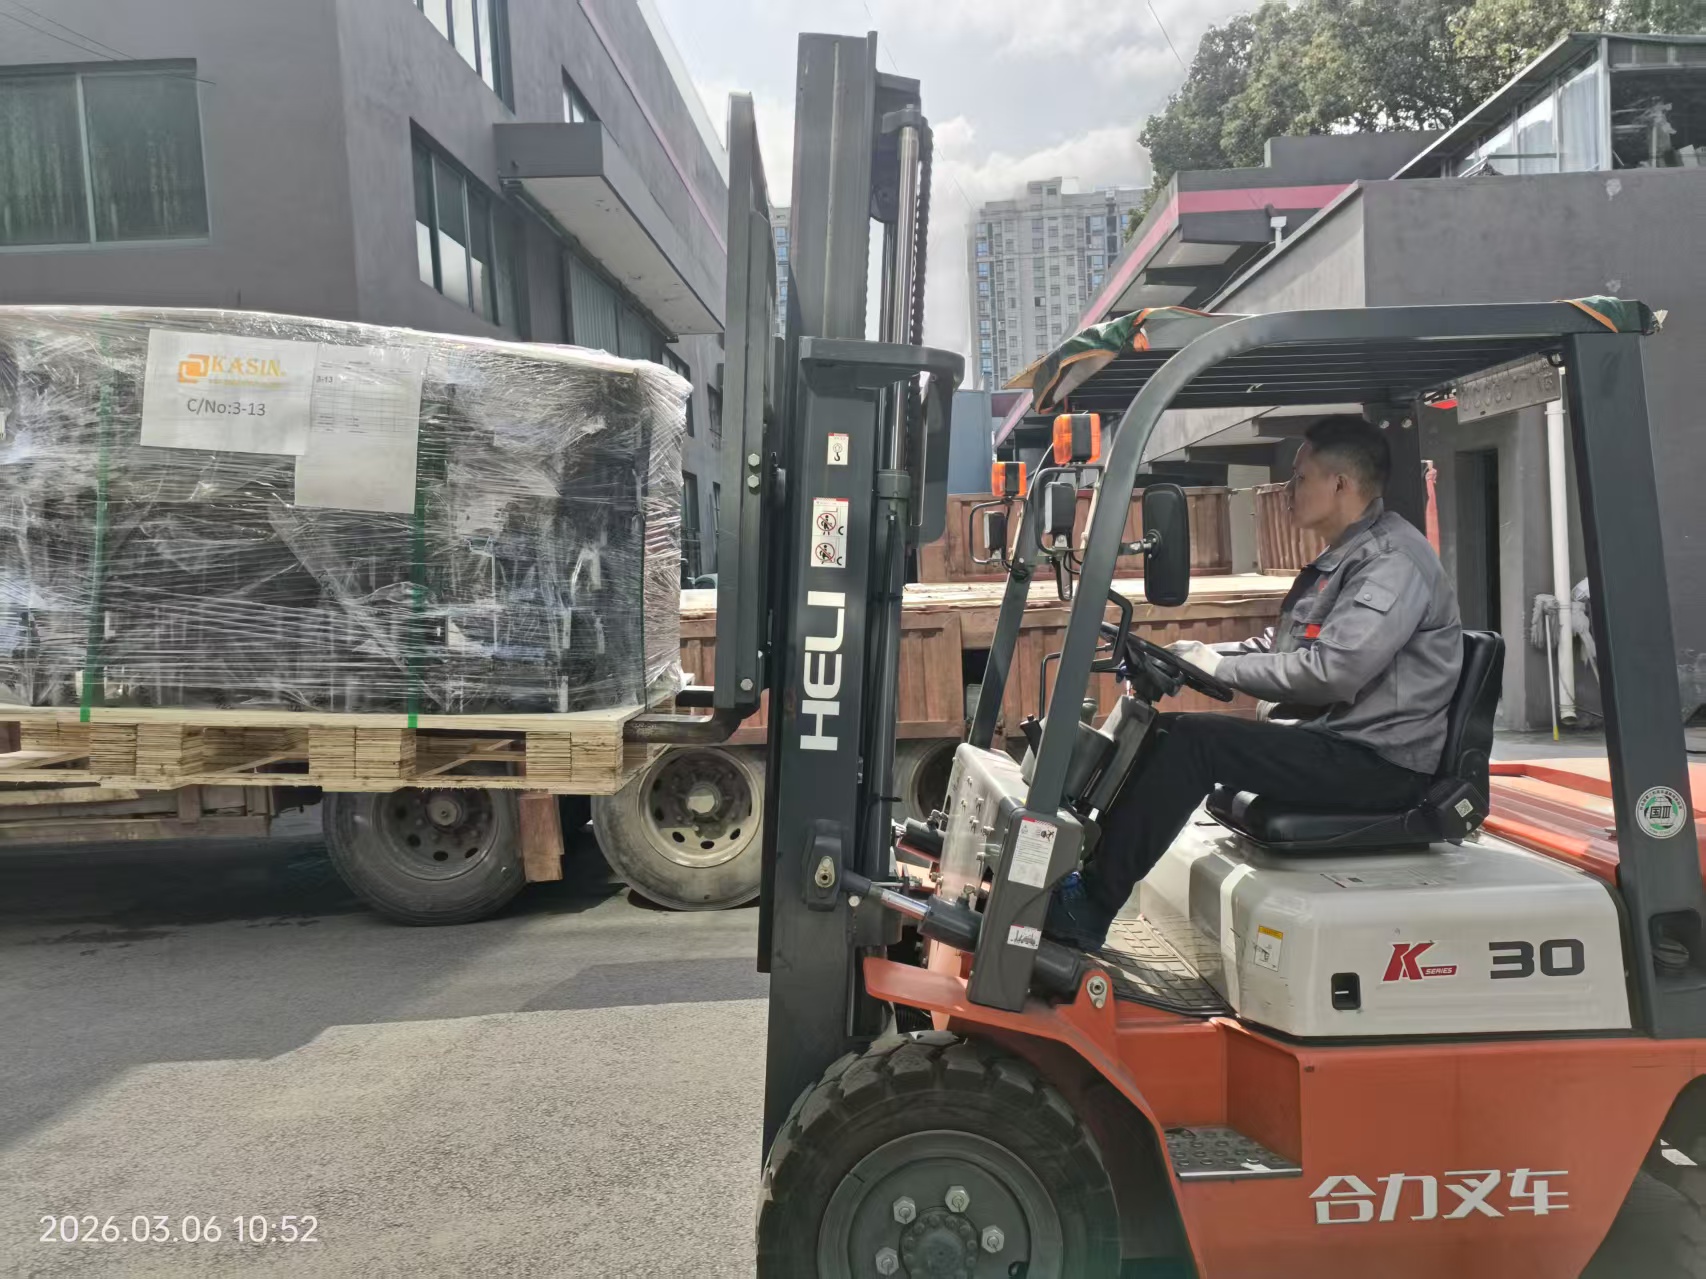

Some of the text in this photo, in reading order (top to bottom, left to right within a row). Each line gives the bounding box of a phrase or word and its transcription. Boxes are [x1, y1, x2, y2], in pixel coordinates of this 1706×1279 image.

[187, 398, 266, 416] C/No:3-13
[800, 591, 846, 751] HELI
[1382, 943, 1453, 982] K SERIES
[1489, 938, 1585, 979] 30
[1308, 1168, 1570, 1225] 合力叉车
